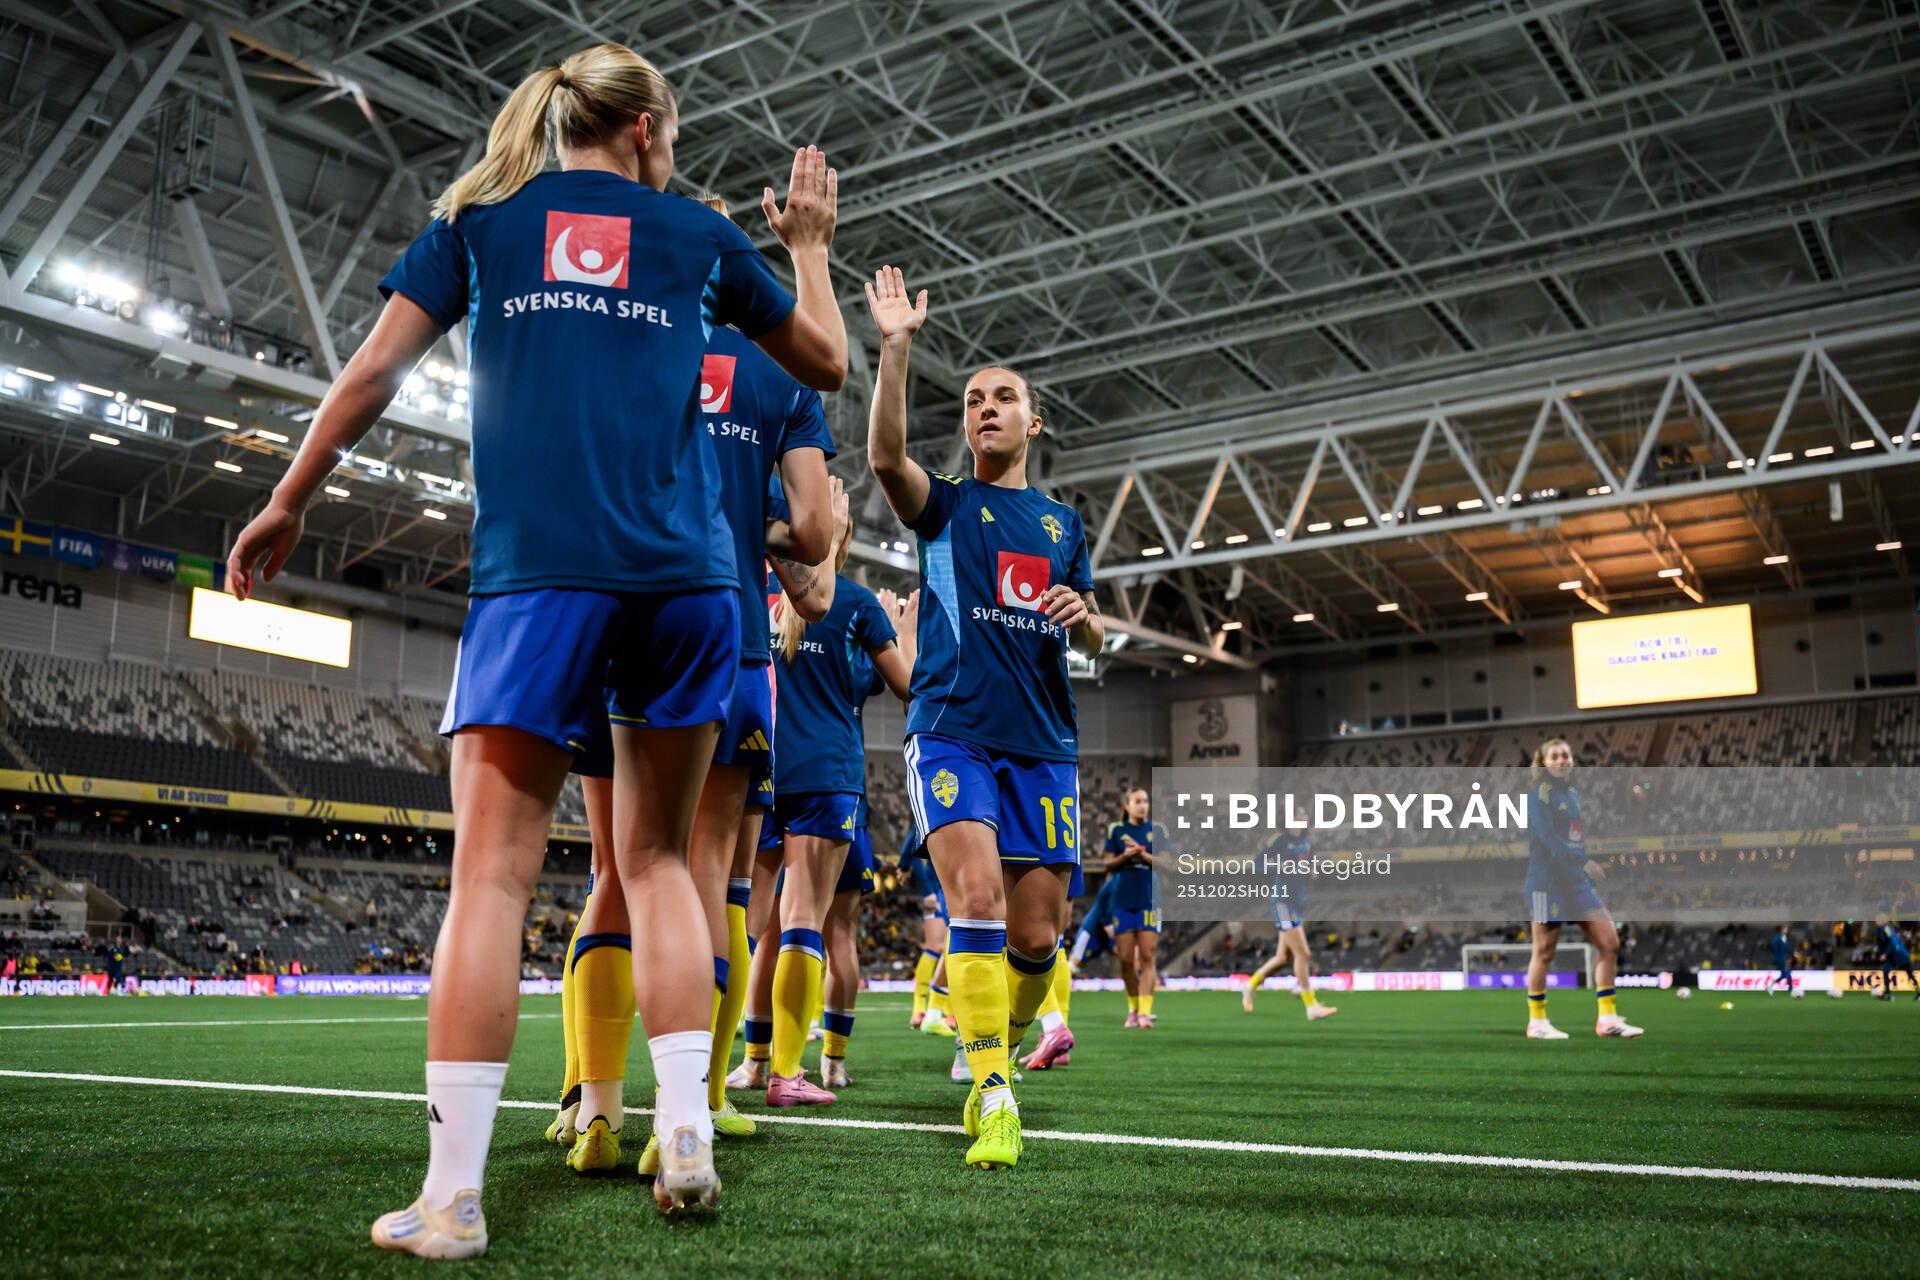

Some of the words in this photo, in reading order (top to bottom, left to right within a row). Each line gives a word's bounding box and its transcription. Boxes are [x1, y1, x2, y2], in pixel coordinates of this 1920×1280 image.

[503, 291, 609, 318] SVENSKA
[616, 300, 673, 328] SPEL
[720, 421, 761, 445] SPEL
[59, 537, 94, 558] FIFA
[142, 555, 176, 574] UEFA
[972, 606, 1036, 631] SVENSKA
[1040, 620, 1060, 638] SPE
[1189, 743, 1240, 759] Arena
[1040, 796, 1075, 849] 15
[299, 980, 332, 994] UEFA
[332, 980, 390, 994] WOMEN'S
[964, 1037, 1003, 1053] SVERIGE
